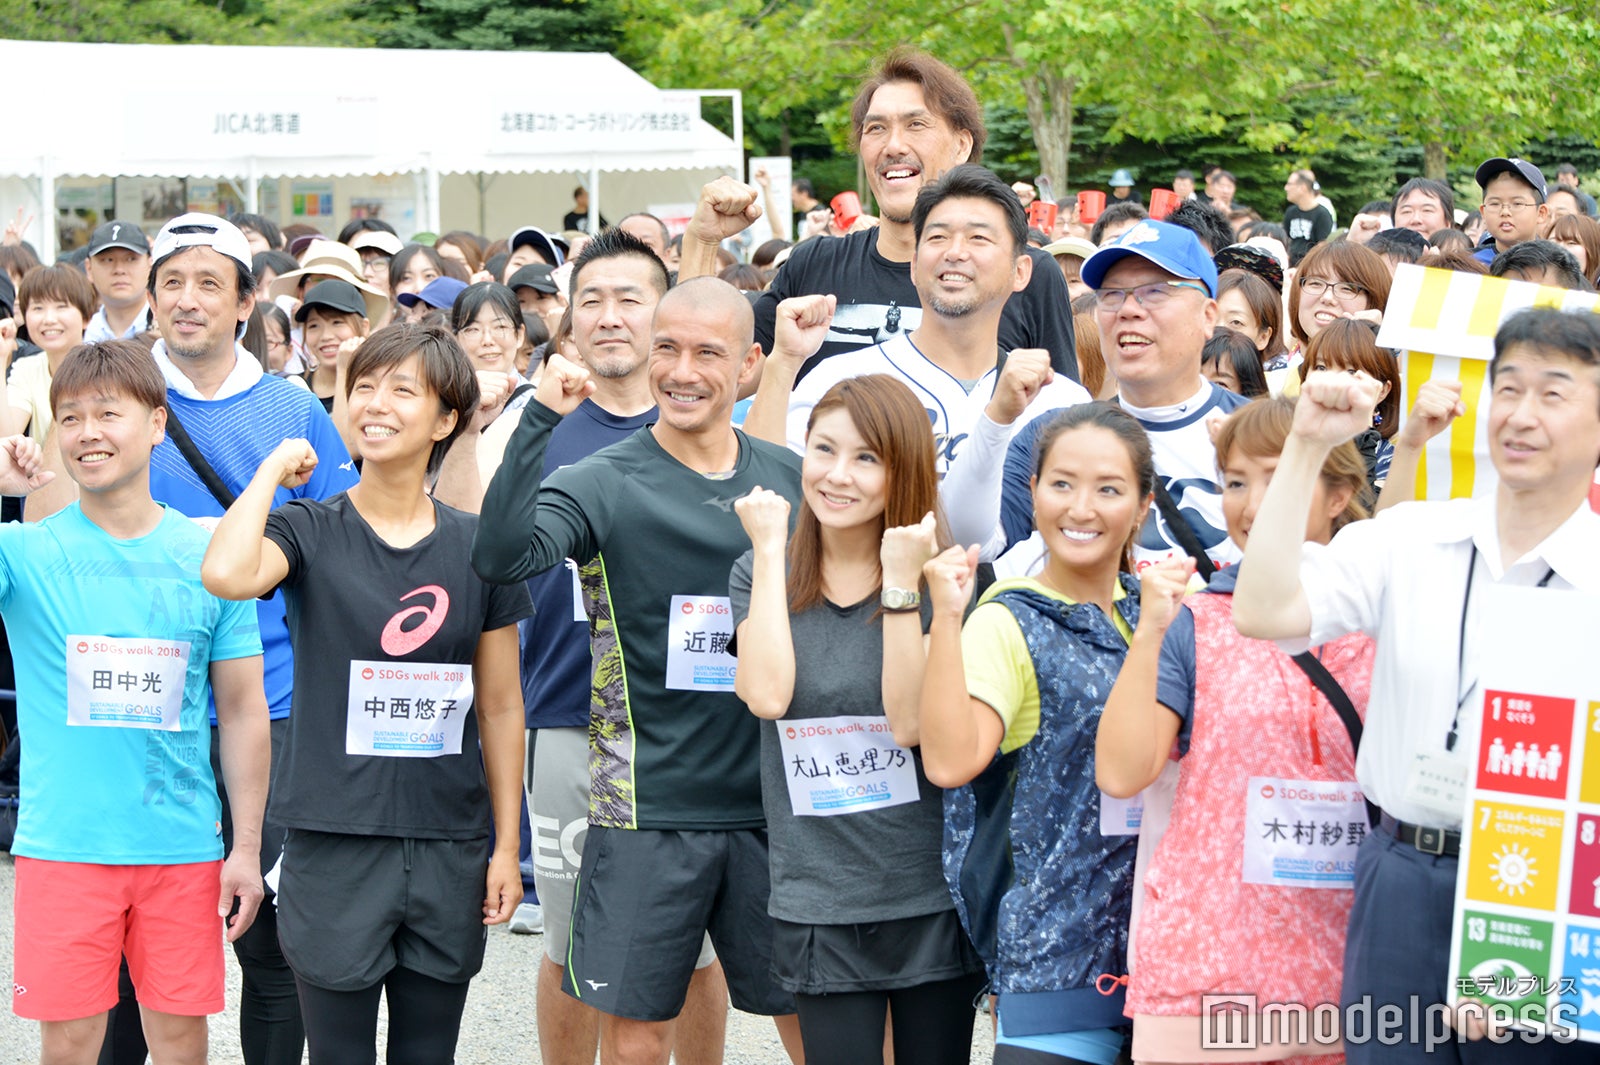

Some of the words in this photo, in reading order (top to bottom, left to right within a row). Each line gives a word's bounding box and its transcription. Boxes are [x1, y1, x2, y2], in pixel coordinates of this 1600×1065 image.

[213, 112, 301, 135] JICA北海道
[699, 603, 729, 615] SDGs
[93, 643, 124, 655] SDGs
[126, 645, 154, 656] walk
[157, 646, 181, 658] 2018
[92, 669, 163, 694] 田中光
[379, 669, 410, 681] SDGs
[413, 670, 440, 681] walk
[443, 671, 464, 682] 2018
[125, 703, 162, 716] GOALS
[364, 695, 458, 721] 中西悠子
[1491, 697, 1502, 721] 1
[409, 732, 445, 744] GOALS
[800, 725, 833, 738] SDGs
[836, 722, 865, 735] walk
[791, 747, 907, 779] 大山恵理乃
[846, 781, 889, 798] GOALS
[1280, 787, 1315, 801] SDGs
[1318, 790, 1347, 802] walk
[1480, 806, 1492, 831] 7
[1580, 819, 1596, 846] 8
[1315, 860, 1355, 872] GOALS
[1467, 917, 1487, 943] 13
[1569, 931, 1591, 958] 14
